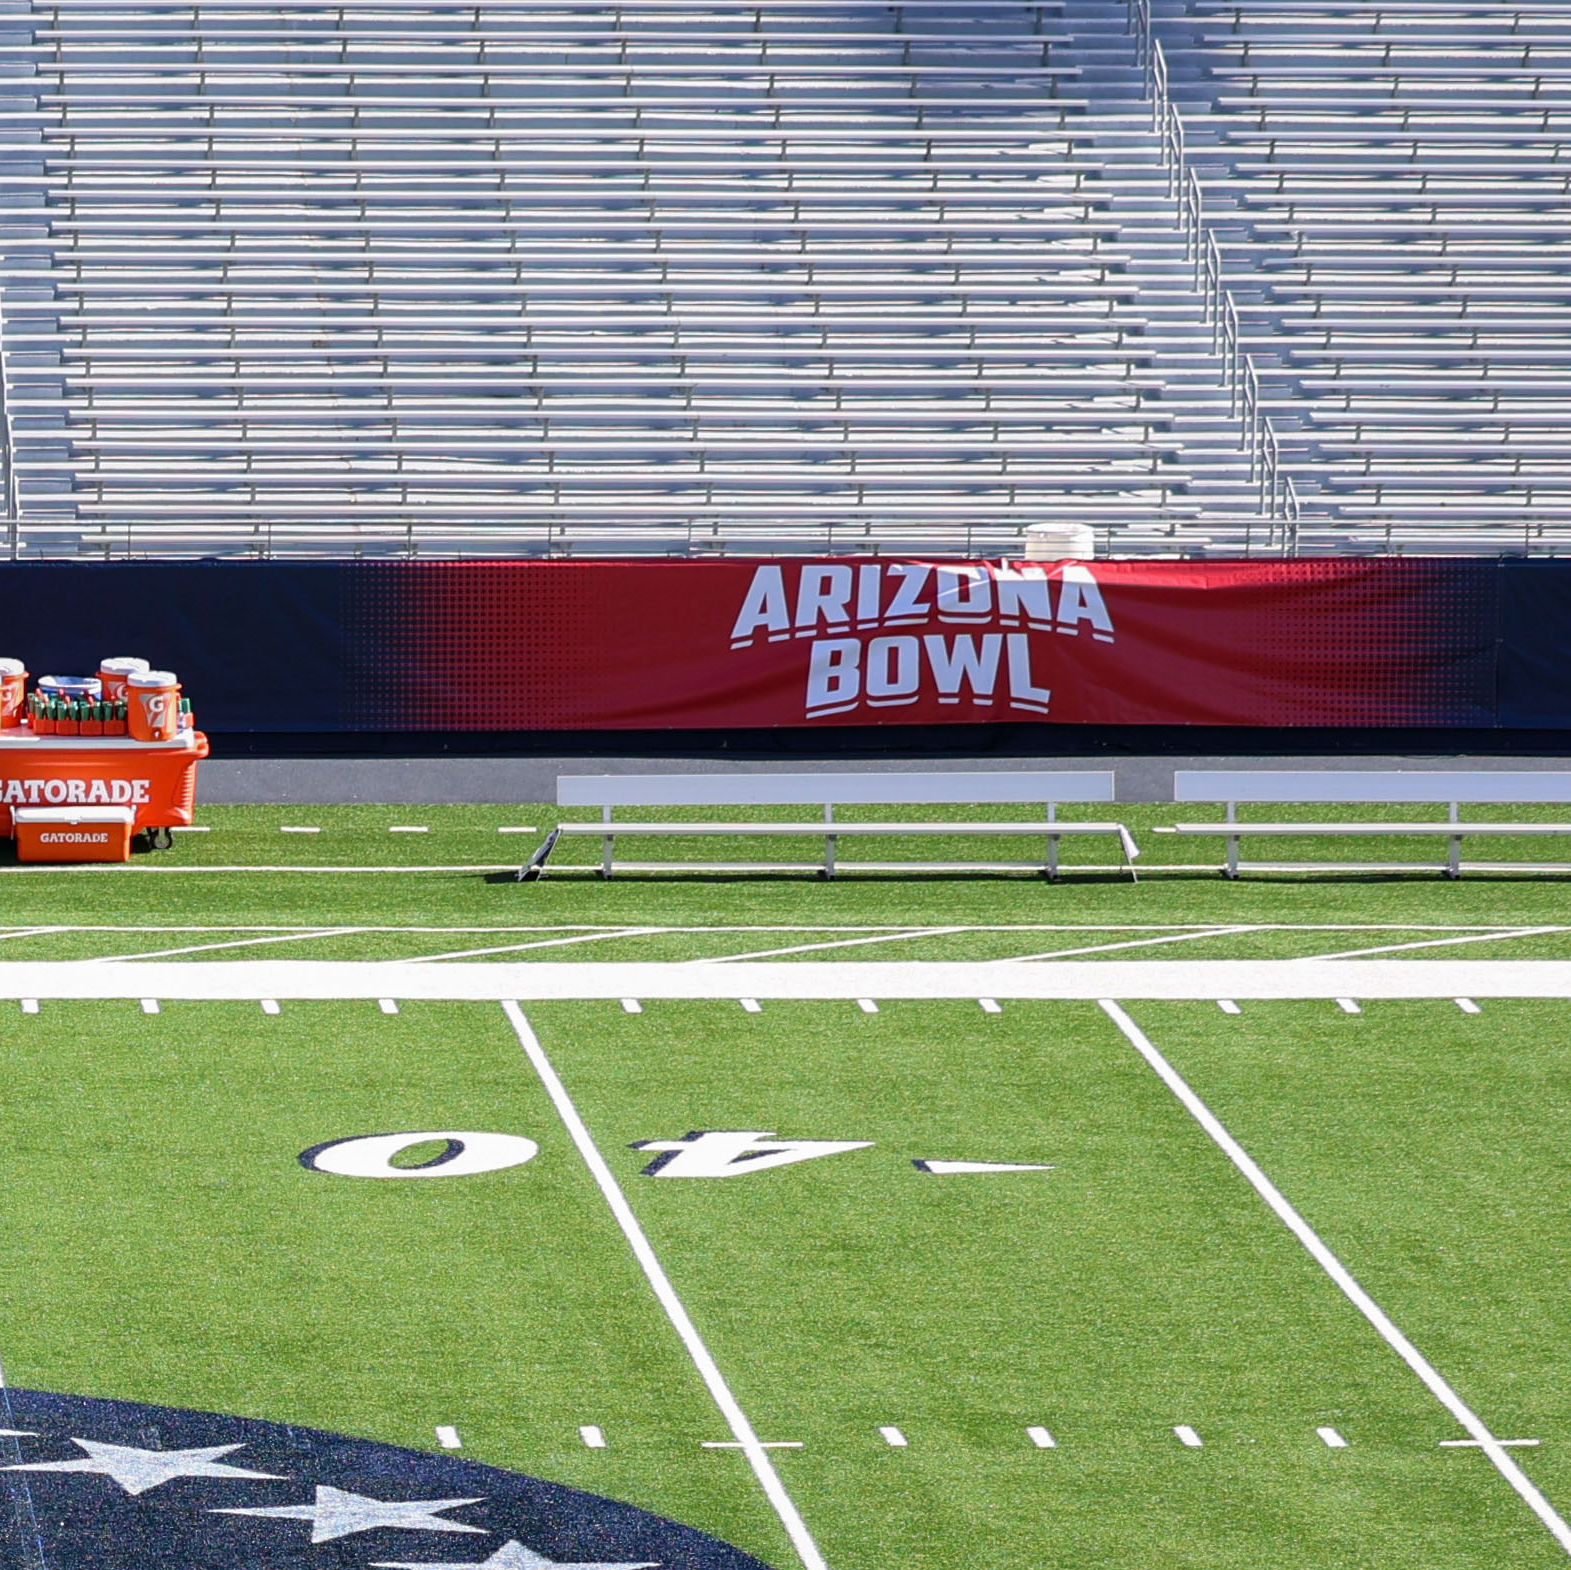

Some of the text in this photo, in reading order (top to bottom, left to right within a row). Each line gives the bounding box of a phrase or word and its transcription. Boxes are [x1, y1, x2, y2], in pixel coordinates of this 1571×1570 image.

[730, 563, 1116, 650] ARIZONA
[805, 632, 1052, 720] BOWL
[149, 695, 164, 713] G
[39, 832, 108, 844] GATORADE
